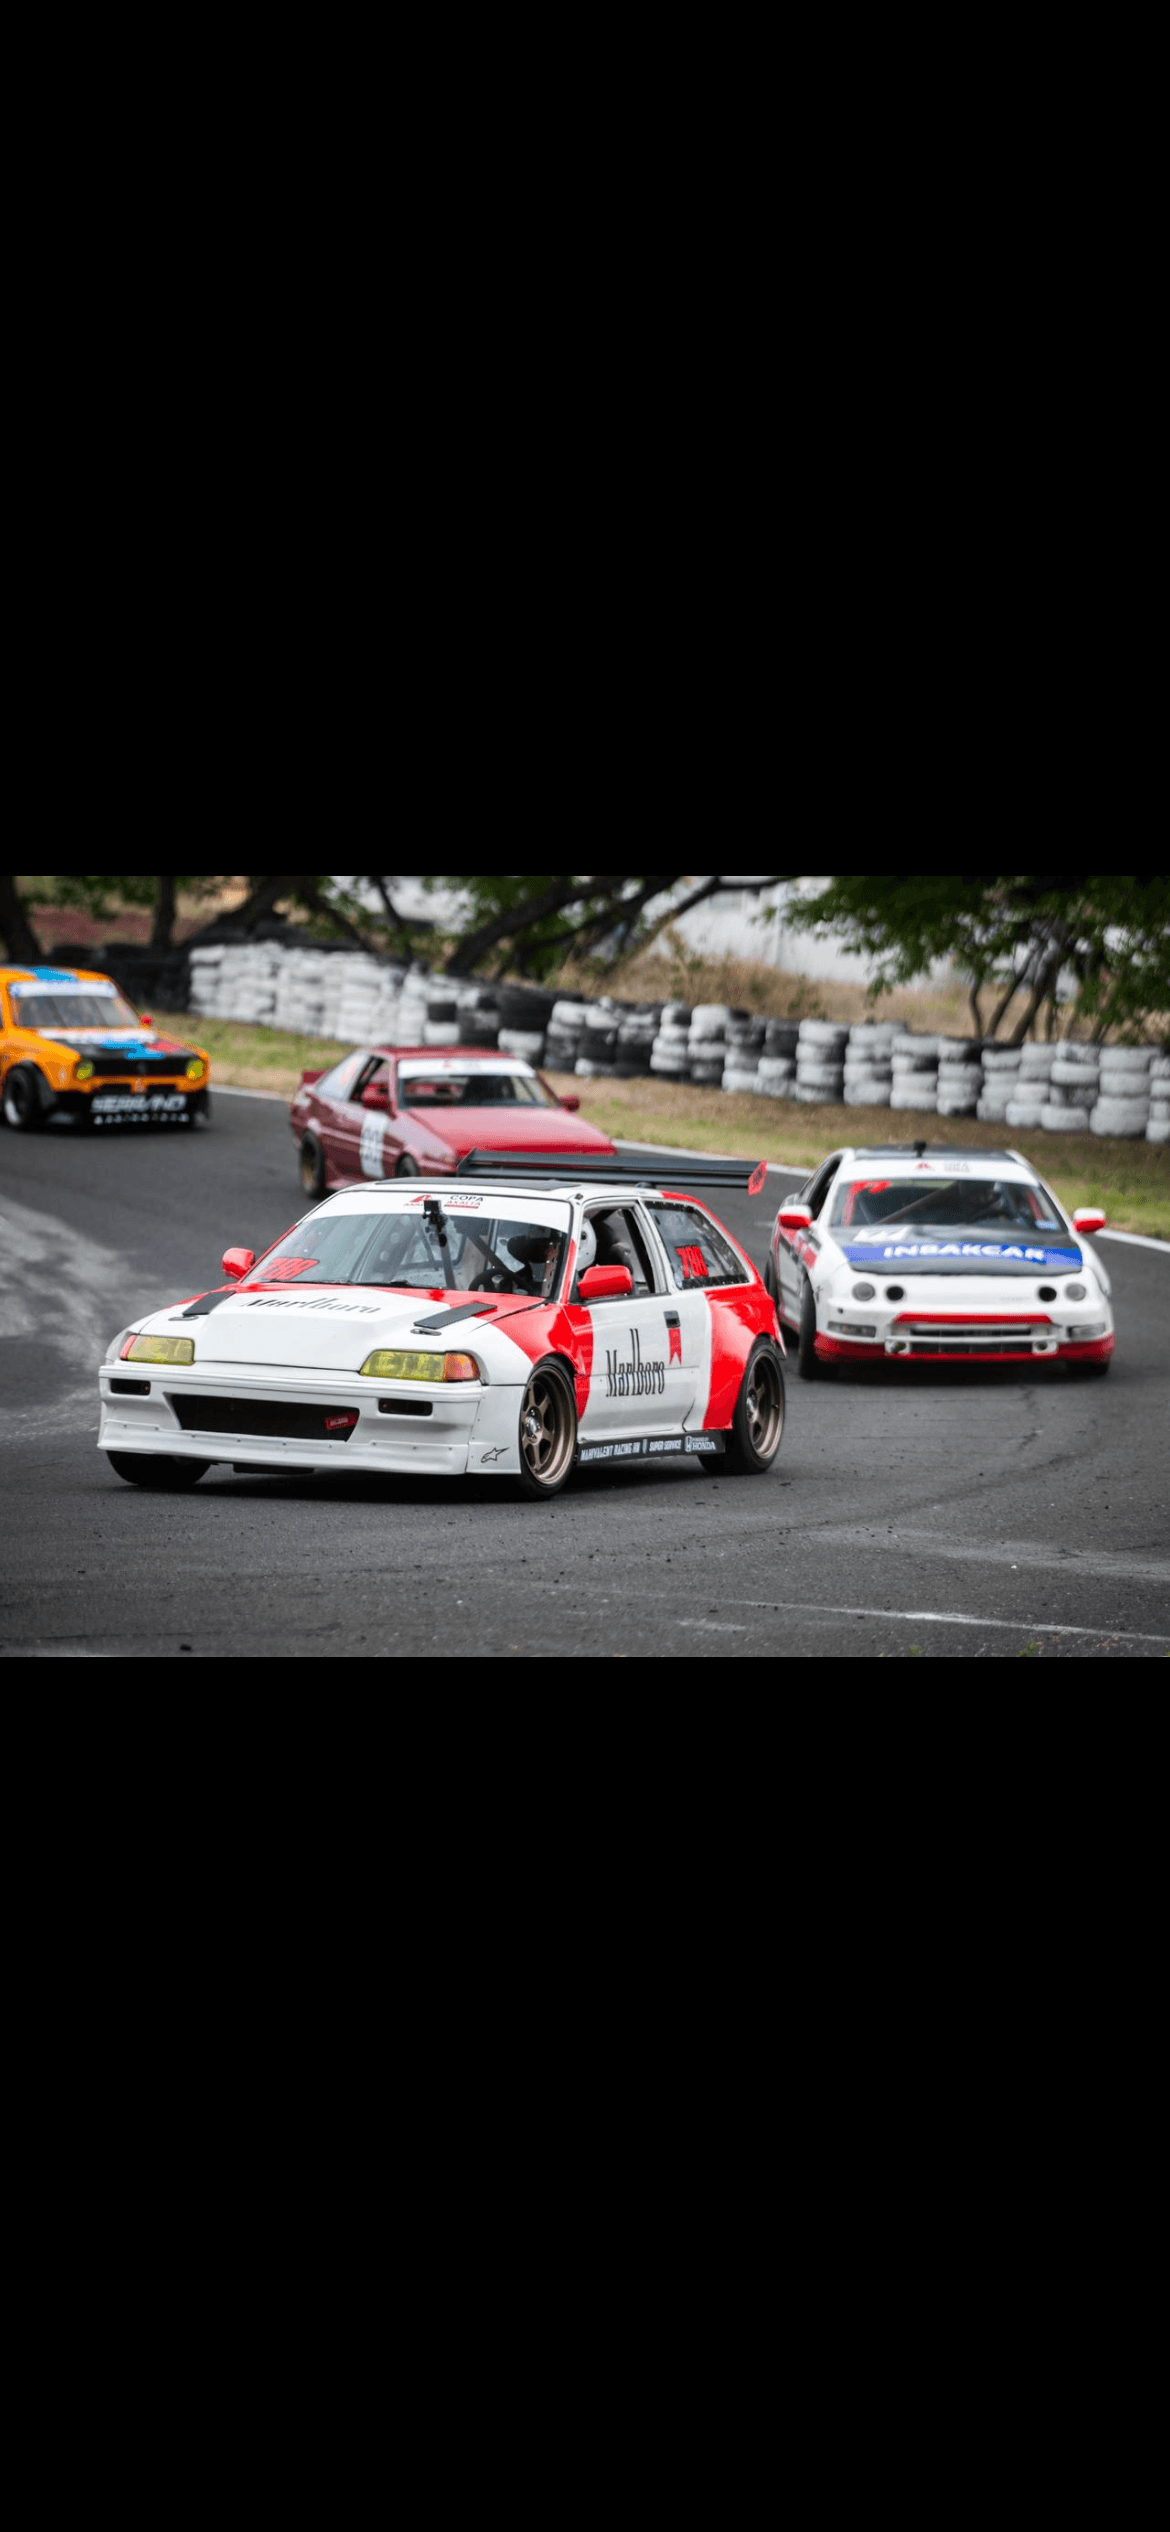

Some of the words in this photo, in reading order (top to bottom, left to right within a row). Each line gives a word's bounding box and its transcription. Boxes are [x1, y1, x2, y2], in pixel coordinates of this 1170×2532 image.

[241, 1297, 382, 1314] Marlboro
[606, 1328, 665, 1397] Marlboro
[692, 1441, 716, 1451] HONDA
